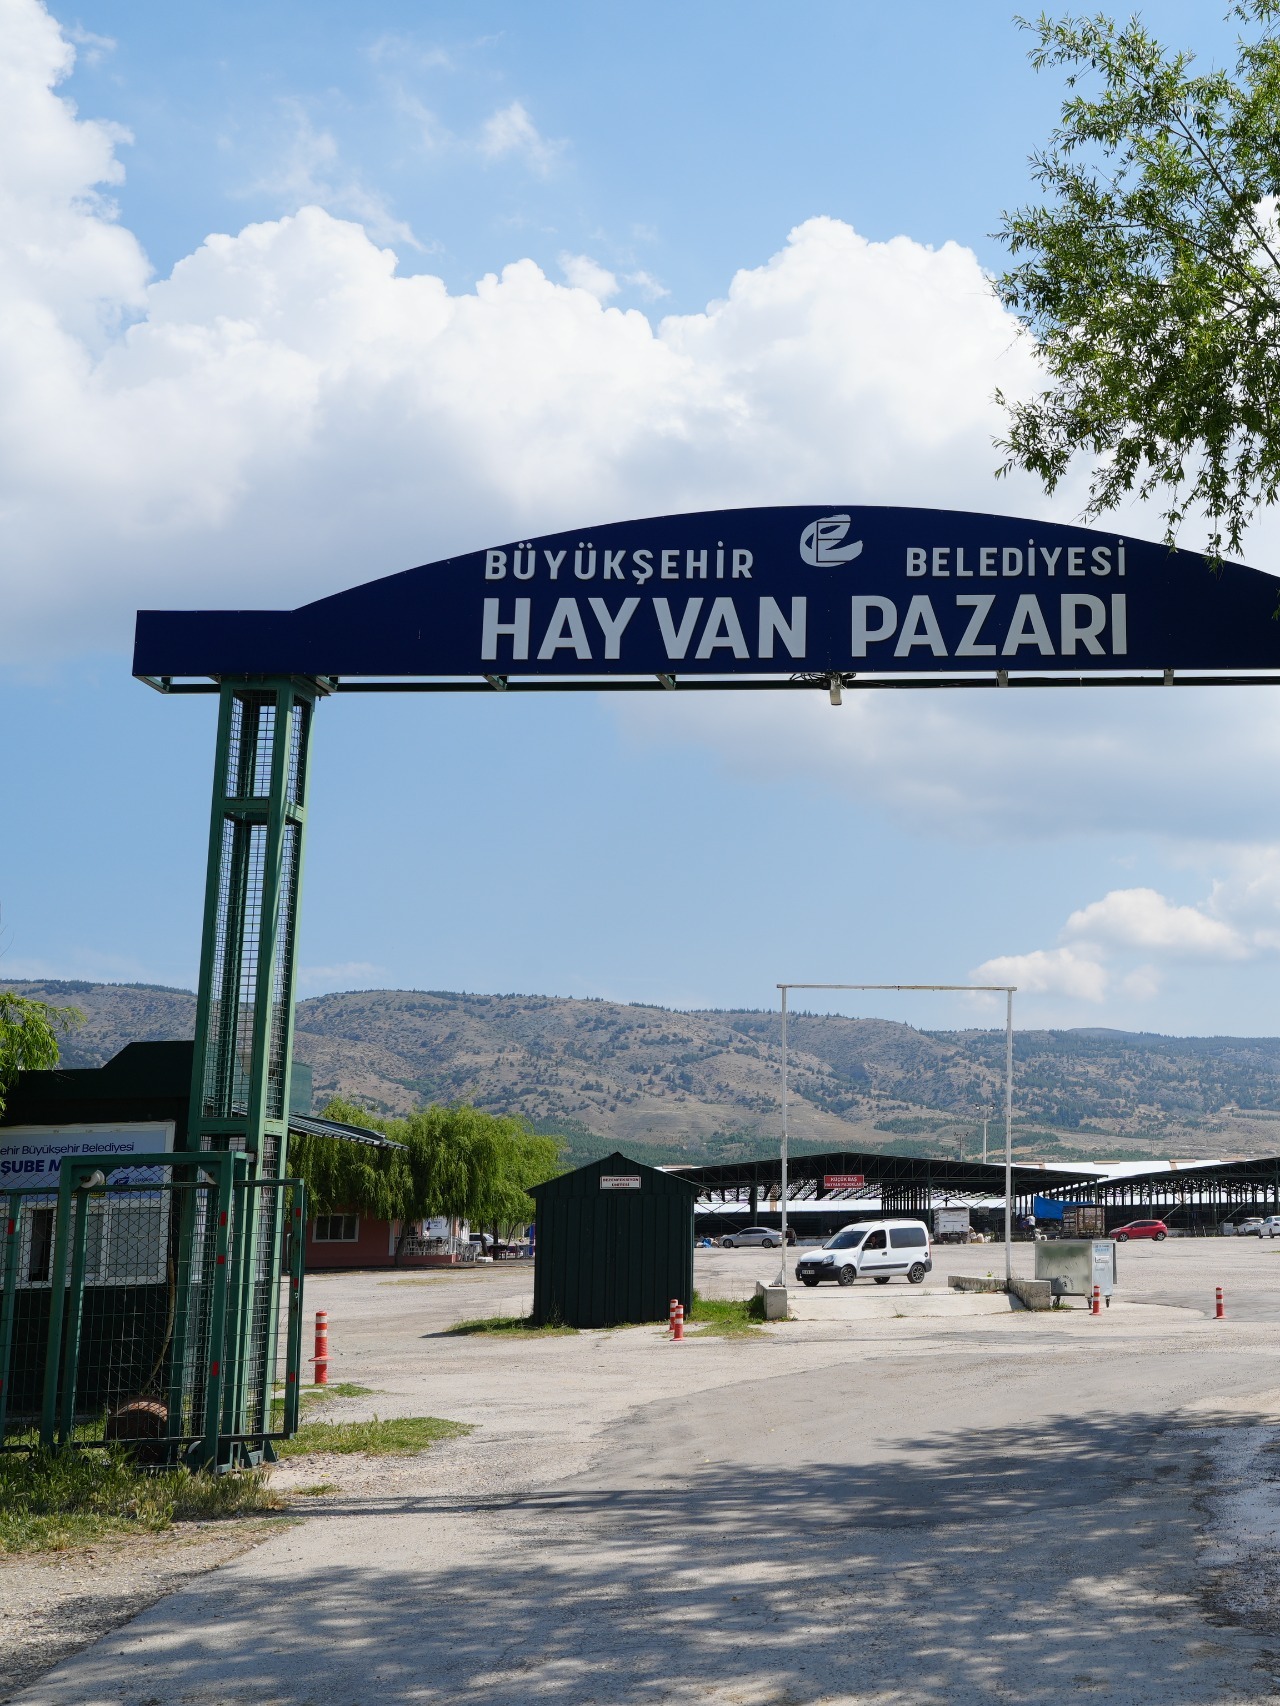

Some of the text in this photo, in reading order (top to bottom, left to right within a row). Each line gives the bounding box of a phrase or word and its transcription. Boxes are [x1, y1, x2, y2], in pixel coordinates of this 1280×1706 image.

[484, 538, 1127, 585] BÜYÜKŞEHİR BELEDİYESİ
[481, 593, 1128, 660] HAYVAN PAZARI
[0, 1141, 135, 1156] ehir Büyükşehir Belediyesi
[1, 1160, 44, 1175] ŞUBE
